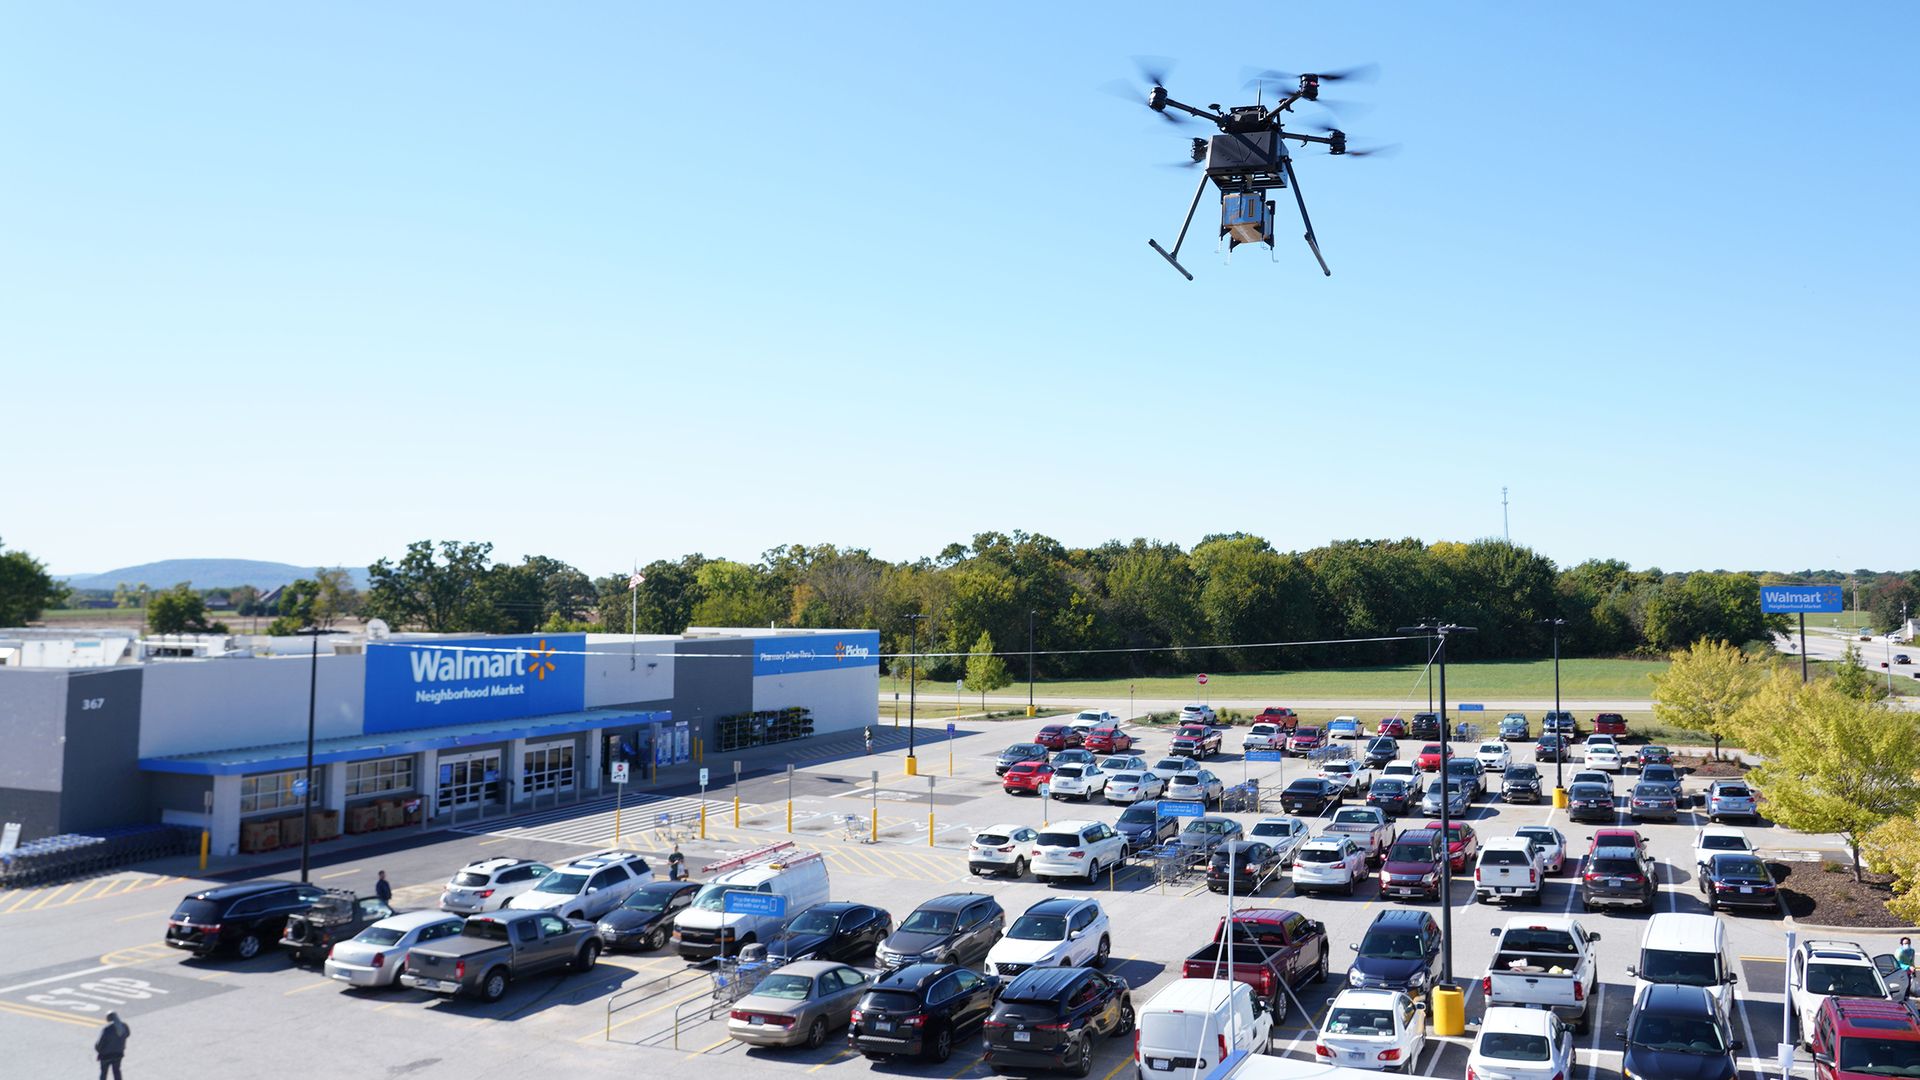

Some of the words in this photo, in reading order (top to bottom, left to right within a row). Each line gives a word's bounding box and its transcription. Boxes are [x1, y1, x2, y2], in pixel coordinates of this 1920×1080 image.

[1765, 592, 1821, 603] Walmart
[845, 644, 869, 660] Pickup
[410, 647, 526, 682] Walmart
[416, 687, 489, 704] Neighborhood
[491, 684, 525, 696] Market
[82, 697, 105, 710] 367
[26, 977, 169, 1012] STOP
